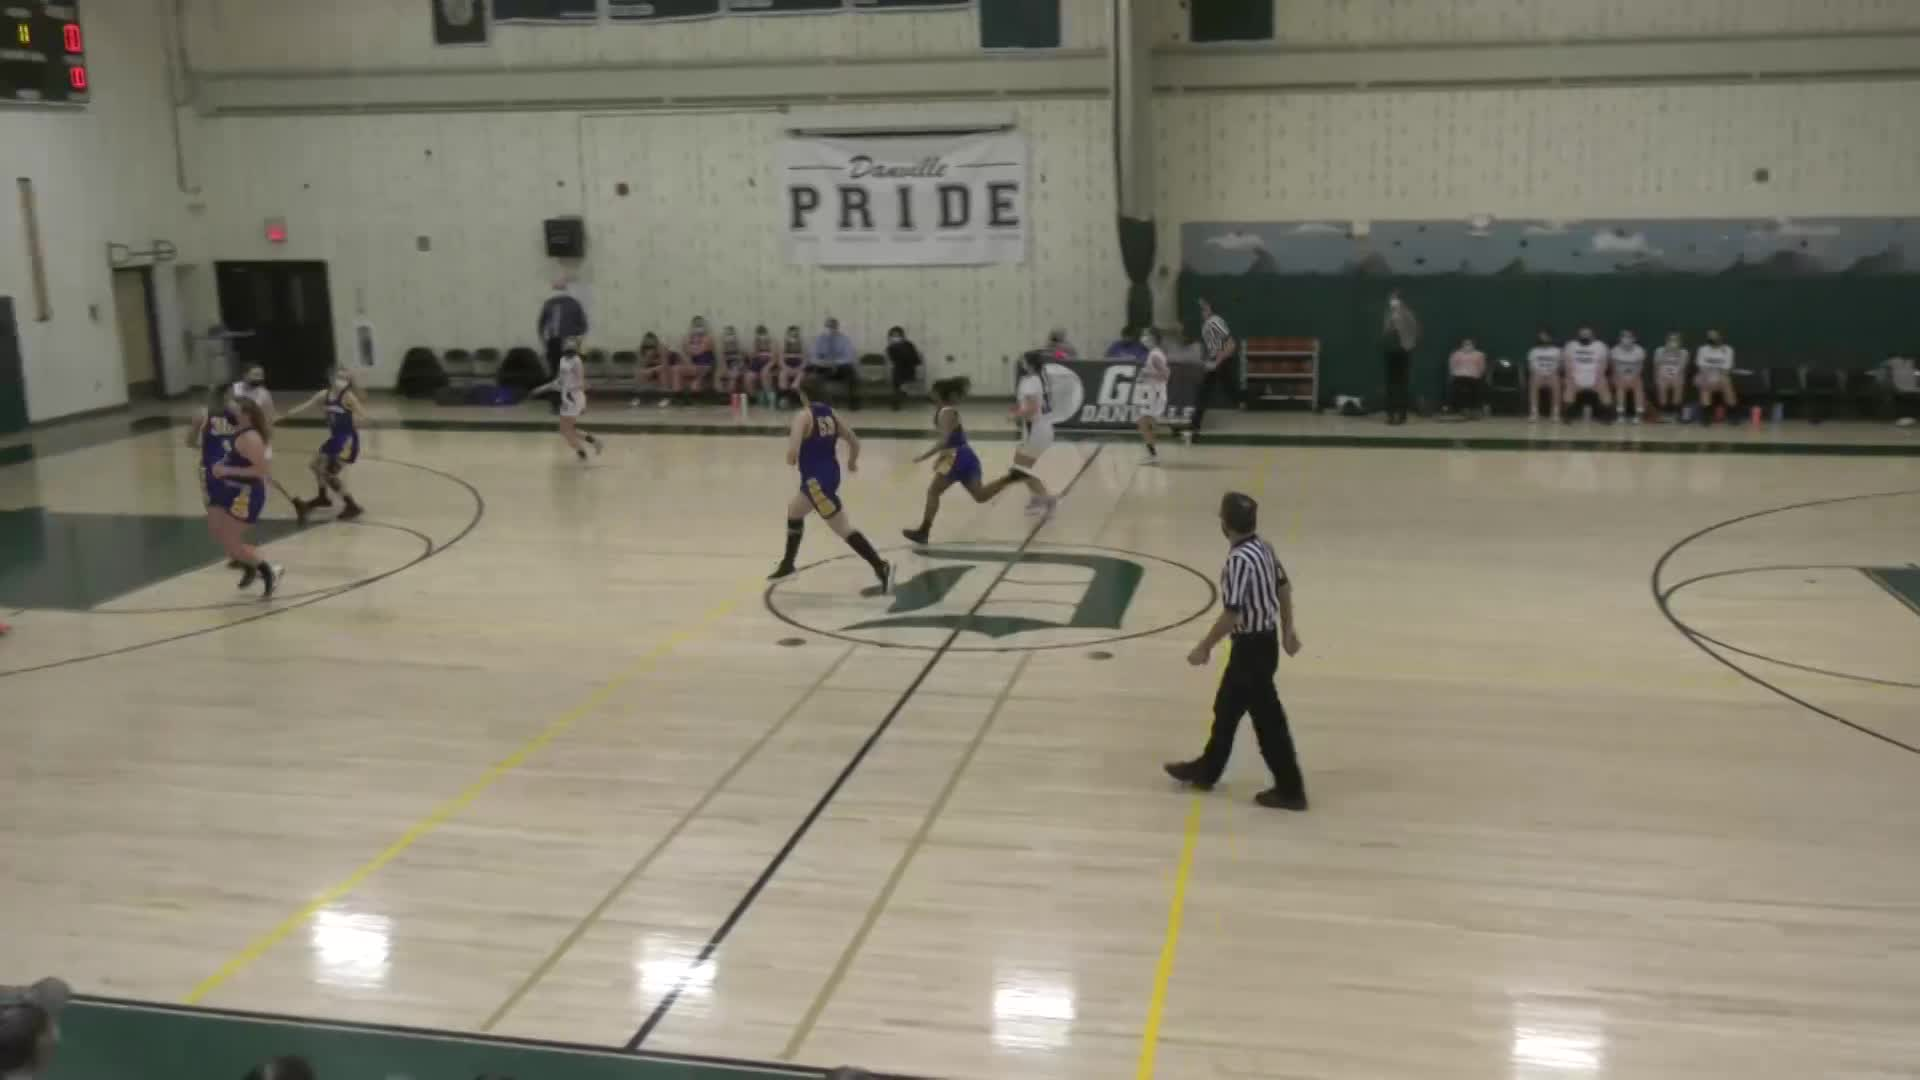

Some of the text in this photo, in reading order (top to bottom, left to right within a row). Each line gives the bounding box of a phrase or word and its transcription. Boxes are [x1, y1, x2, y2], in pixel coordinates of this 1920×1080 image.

[848, 154, 949, 179] Danville
[788, 182, 1021, 229] PRIDE
[1080, 405, 1196, 424] DANVLE
